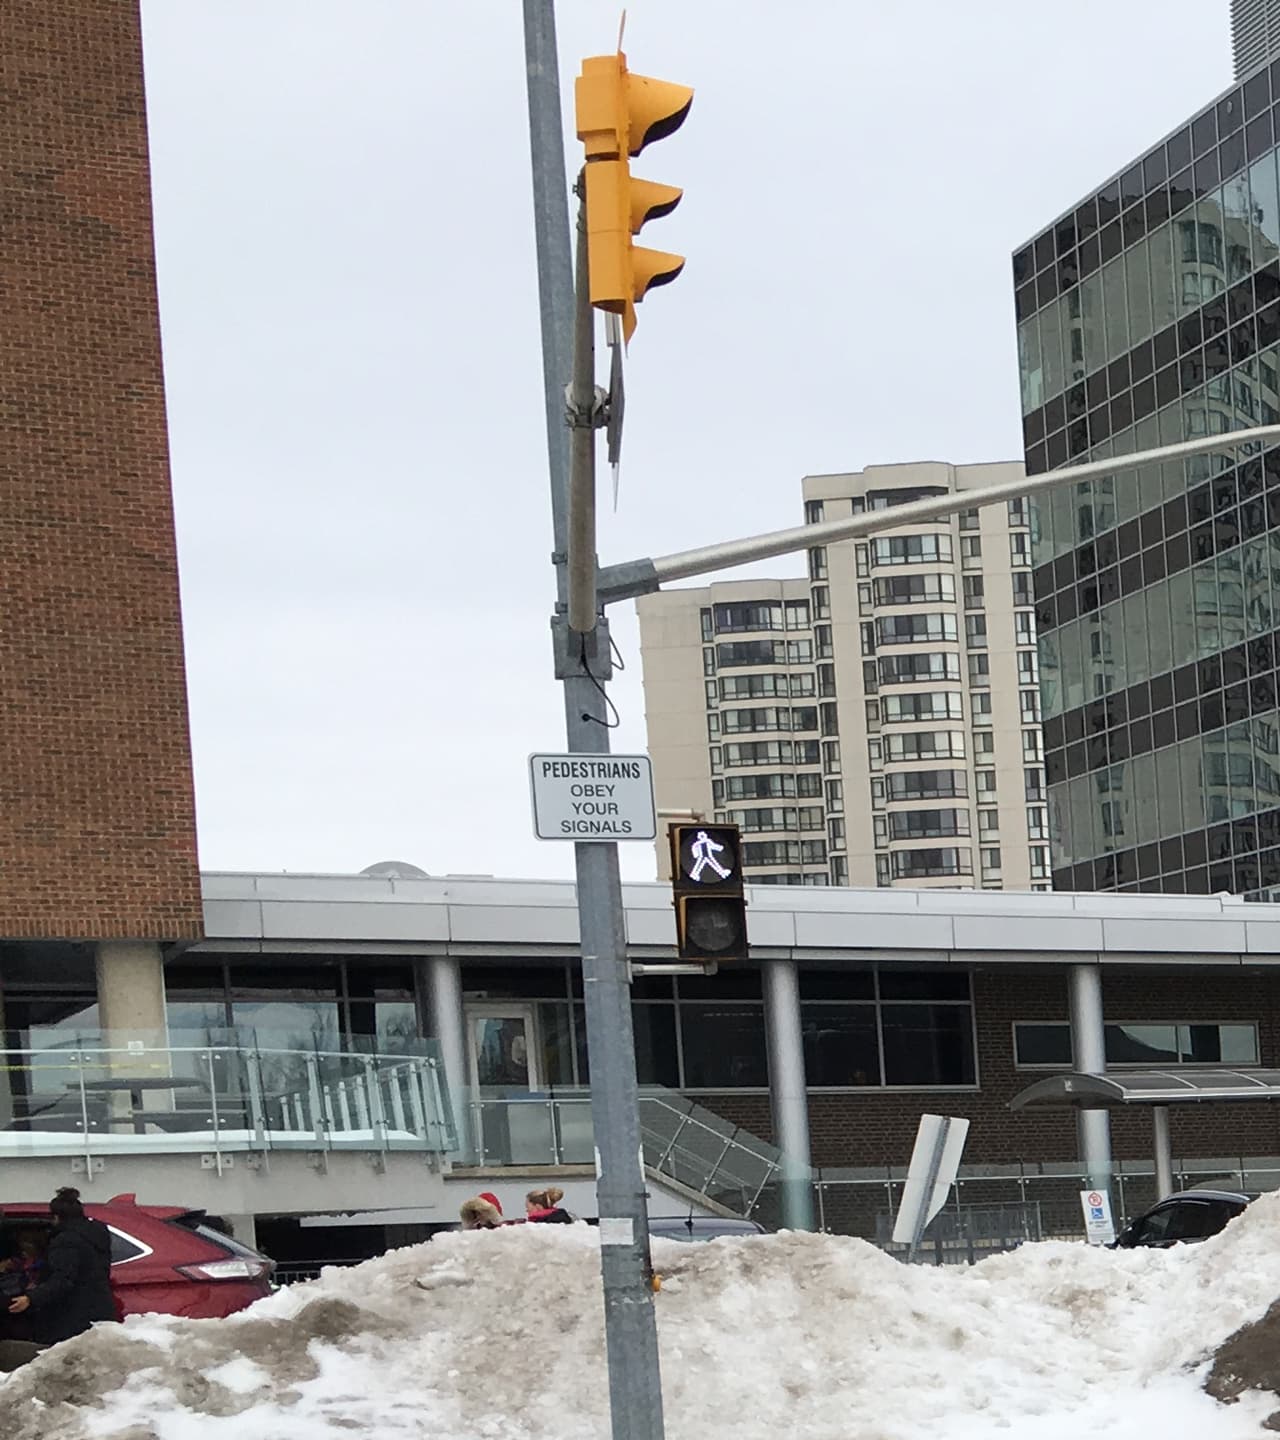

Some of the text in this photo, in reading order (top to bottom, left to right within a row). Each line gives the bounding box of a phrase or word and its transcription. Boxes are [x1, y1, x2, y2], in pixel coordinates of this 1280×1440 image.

[542, 761, 641, 779] PEDESTRIANS
[570, 784, 616, 797] OBEY
[572, 802, 619, 815] YOUR
[561, 820, 632, 833] SIGNALS
